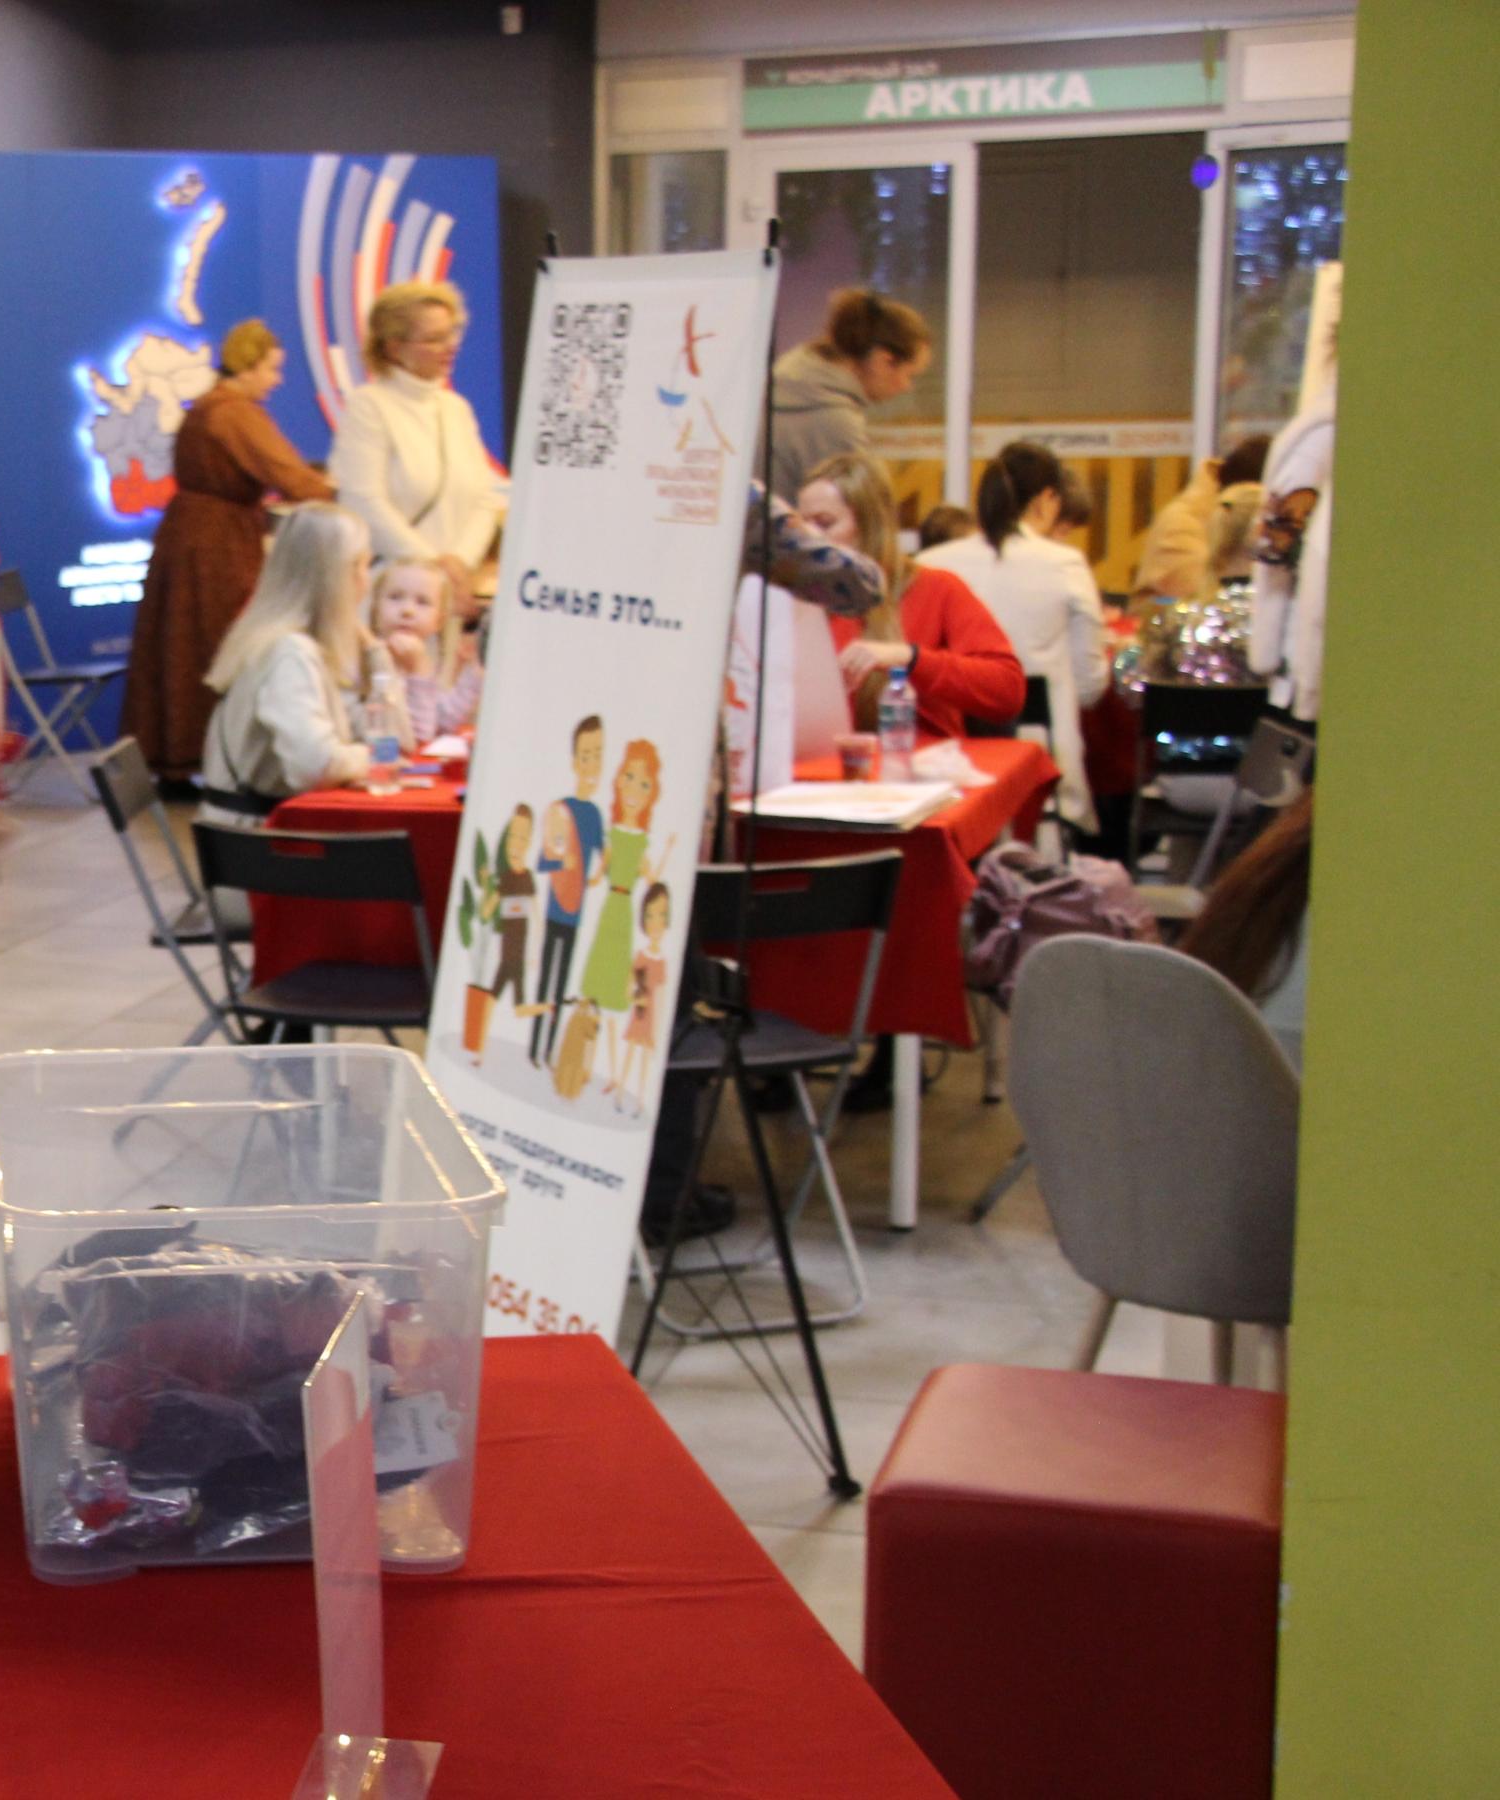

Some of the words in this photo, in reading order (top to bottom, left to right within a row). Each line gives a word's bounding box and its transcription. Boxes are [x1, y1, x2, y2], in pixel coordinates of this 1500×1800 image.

[864, 73, 1093, 119] АРКТИКА
[518, 569, 601, 618] Семья
[610, 593, 683, 630] это...
